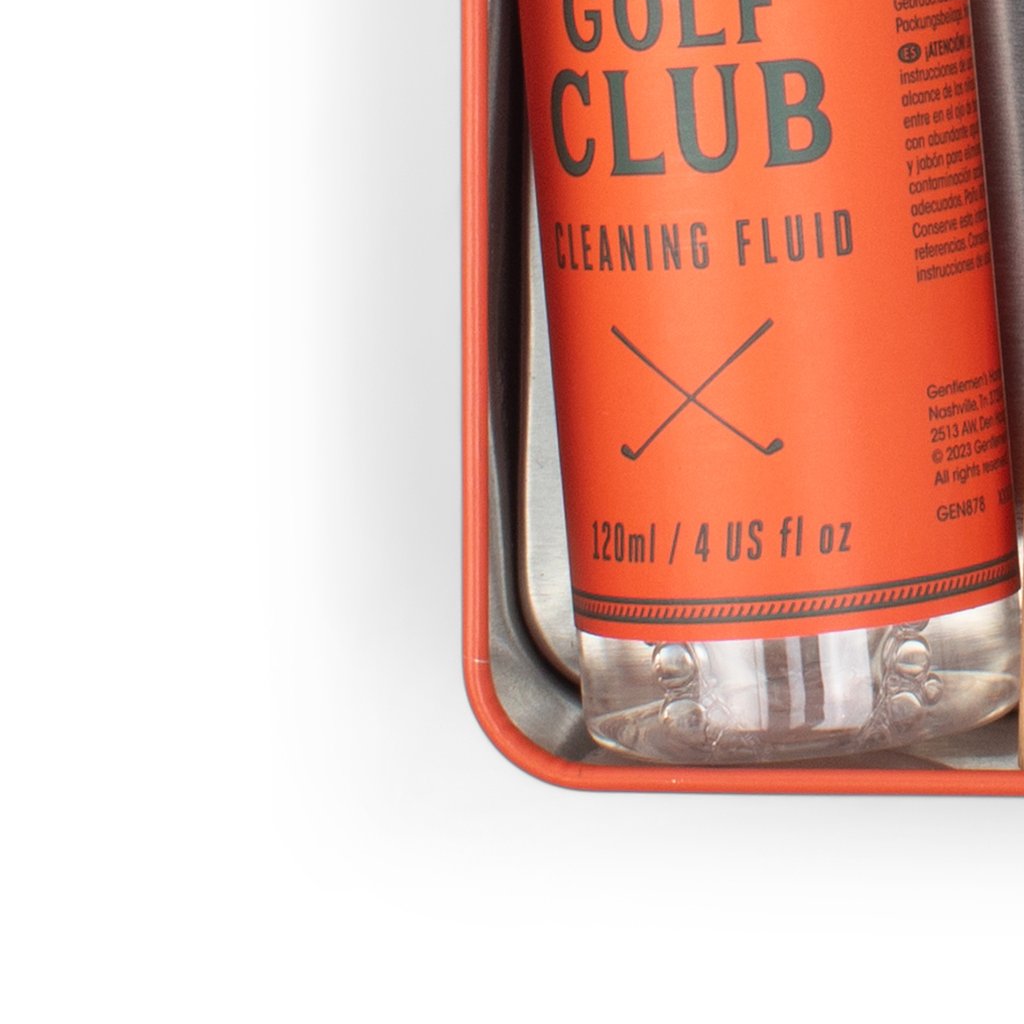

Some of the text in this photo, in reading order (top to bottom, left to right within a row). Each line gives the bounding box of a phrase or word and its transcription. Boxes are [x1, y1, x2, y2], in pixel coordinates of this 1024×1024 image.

[900, 43, 919, 62] ES
[899, 62, 958, 86] instrucciones
[901, 88, 941, 108] alcance
[943, 83, 953, 100] de
[551, 57, 833, 178] CLUB
[903, 112, 930, 129] entre
[932, 109, 944, 124] en
[946, 103, 953, 120] el
[905, 135, 925, 151] con
[906, 159, 913, 177] y
[916, 151, 944, 176] jabón
[945, 149, 963, 168] para
[554, 209, 854, 272] CLEANING FLUID
[912, 218, 957, 239] Conserve
[916, 258, 974, 284] instrucciones
[931, 423, 959, 443] 2513
[946, 441, 972, 462] 2023
[934, 469, 949, 487] All
[952, 462, 980, 484] rights
[936, 495, 986, 522] GEN878
[592, 515, 852, 565] 120ml / 4 US fl oz
